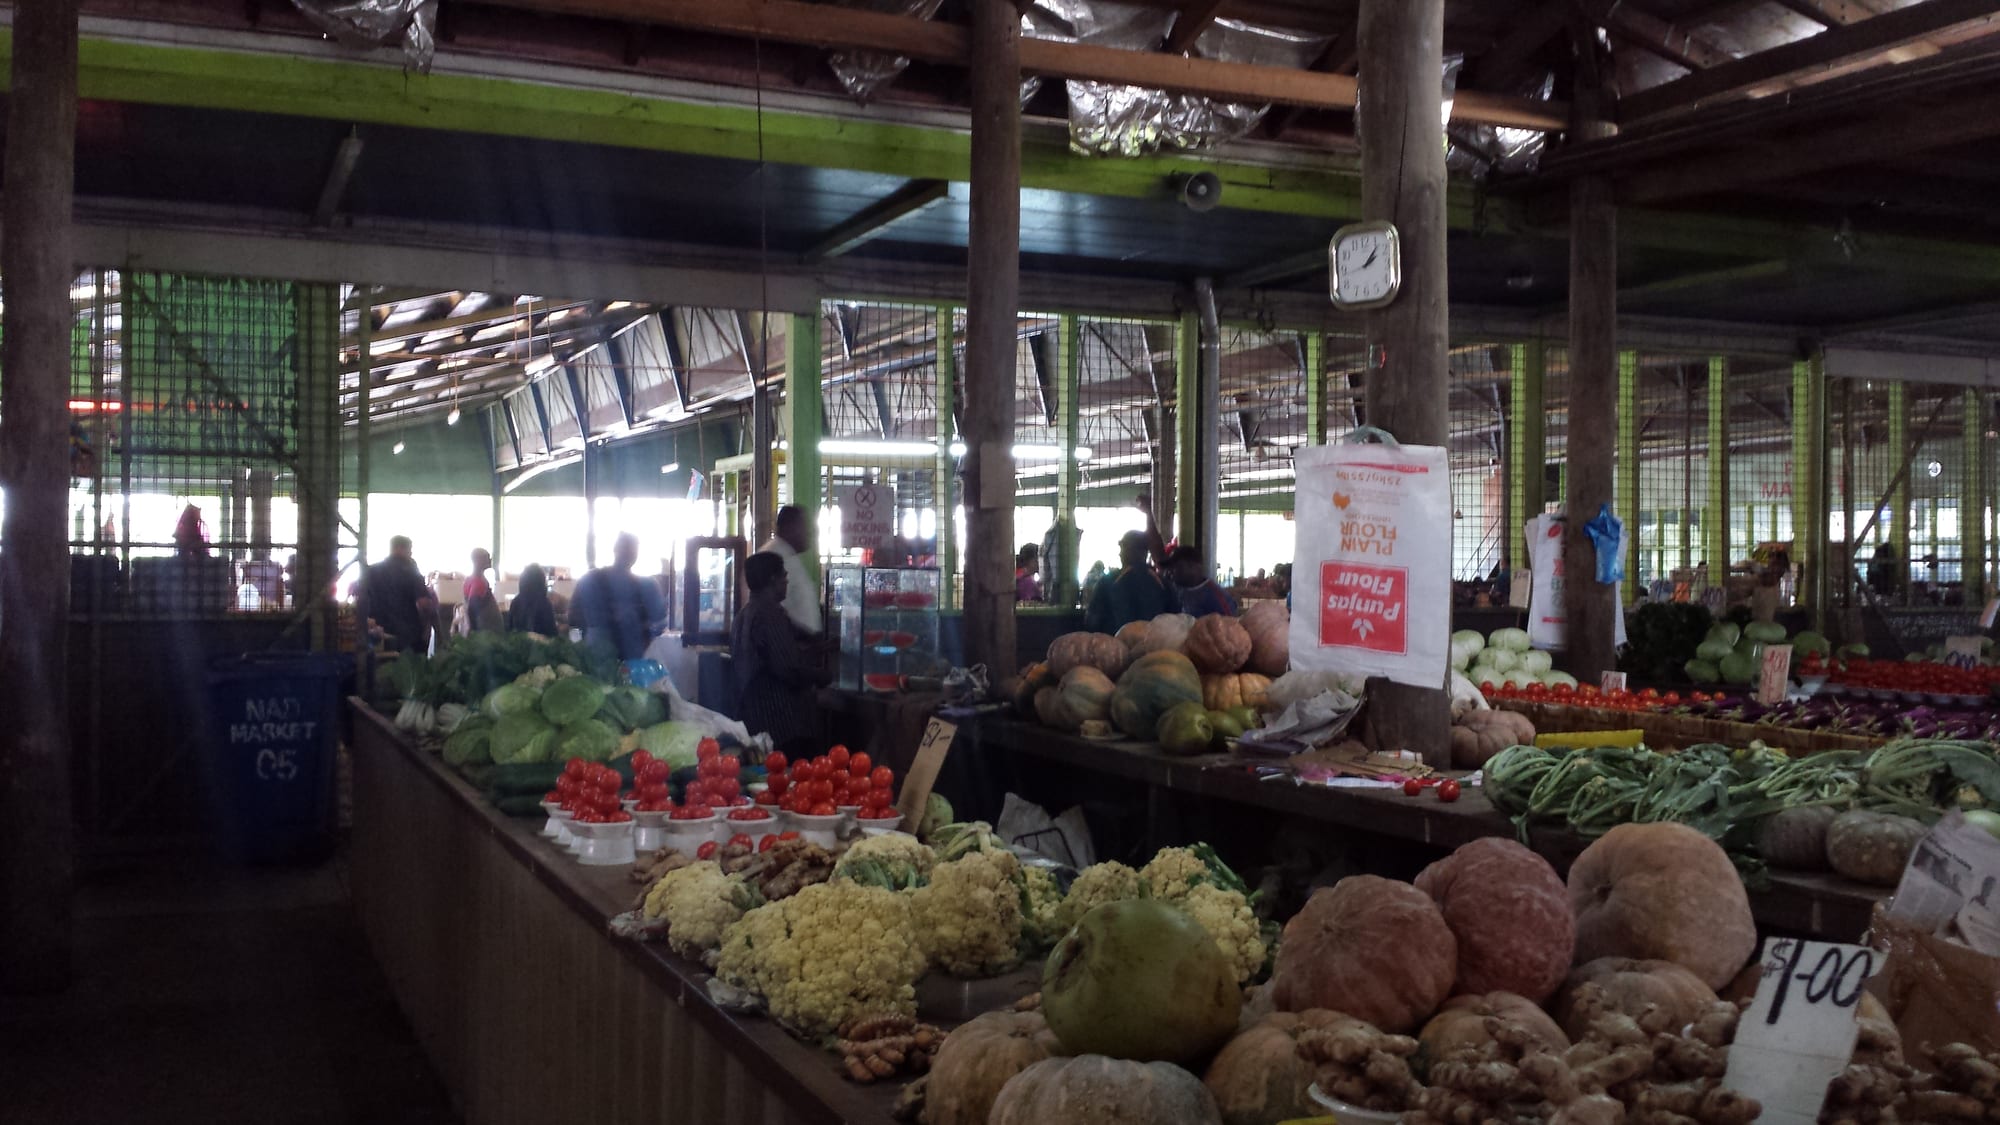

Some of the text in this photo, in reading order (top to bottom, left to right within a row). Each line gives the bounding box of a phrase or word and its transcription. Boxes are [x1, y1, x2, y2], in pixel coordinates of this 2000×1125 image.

[1361, 236, 1369, 248] 12
[856, 510, 874, 520] NO
[844, 522, 890, 534] SMOKING
[1340, 520, 1397, 541] FLOUR
[852, 536, 882, 546] ZONE
[1340, 536, 1393, 556] PLAIN
[1337, 571, 1394, 596] Flour
[1327, 594, 1401, 621] Punjas
[231, 721, 317, 743] MARKET
[256, 748, 298, 780] 05
